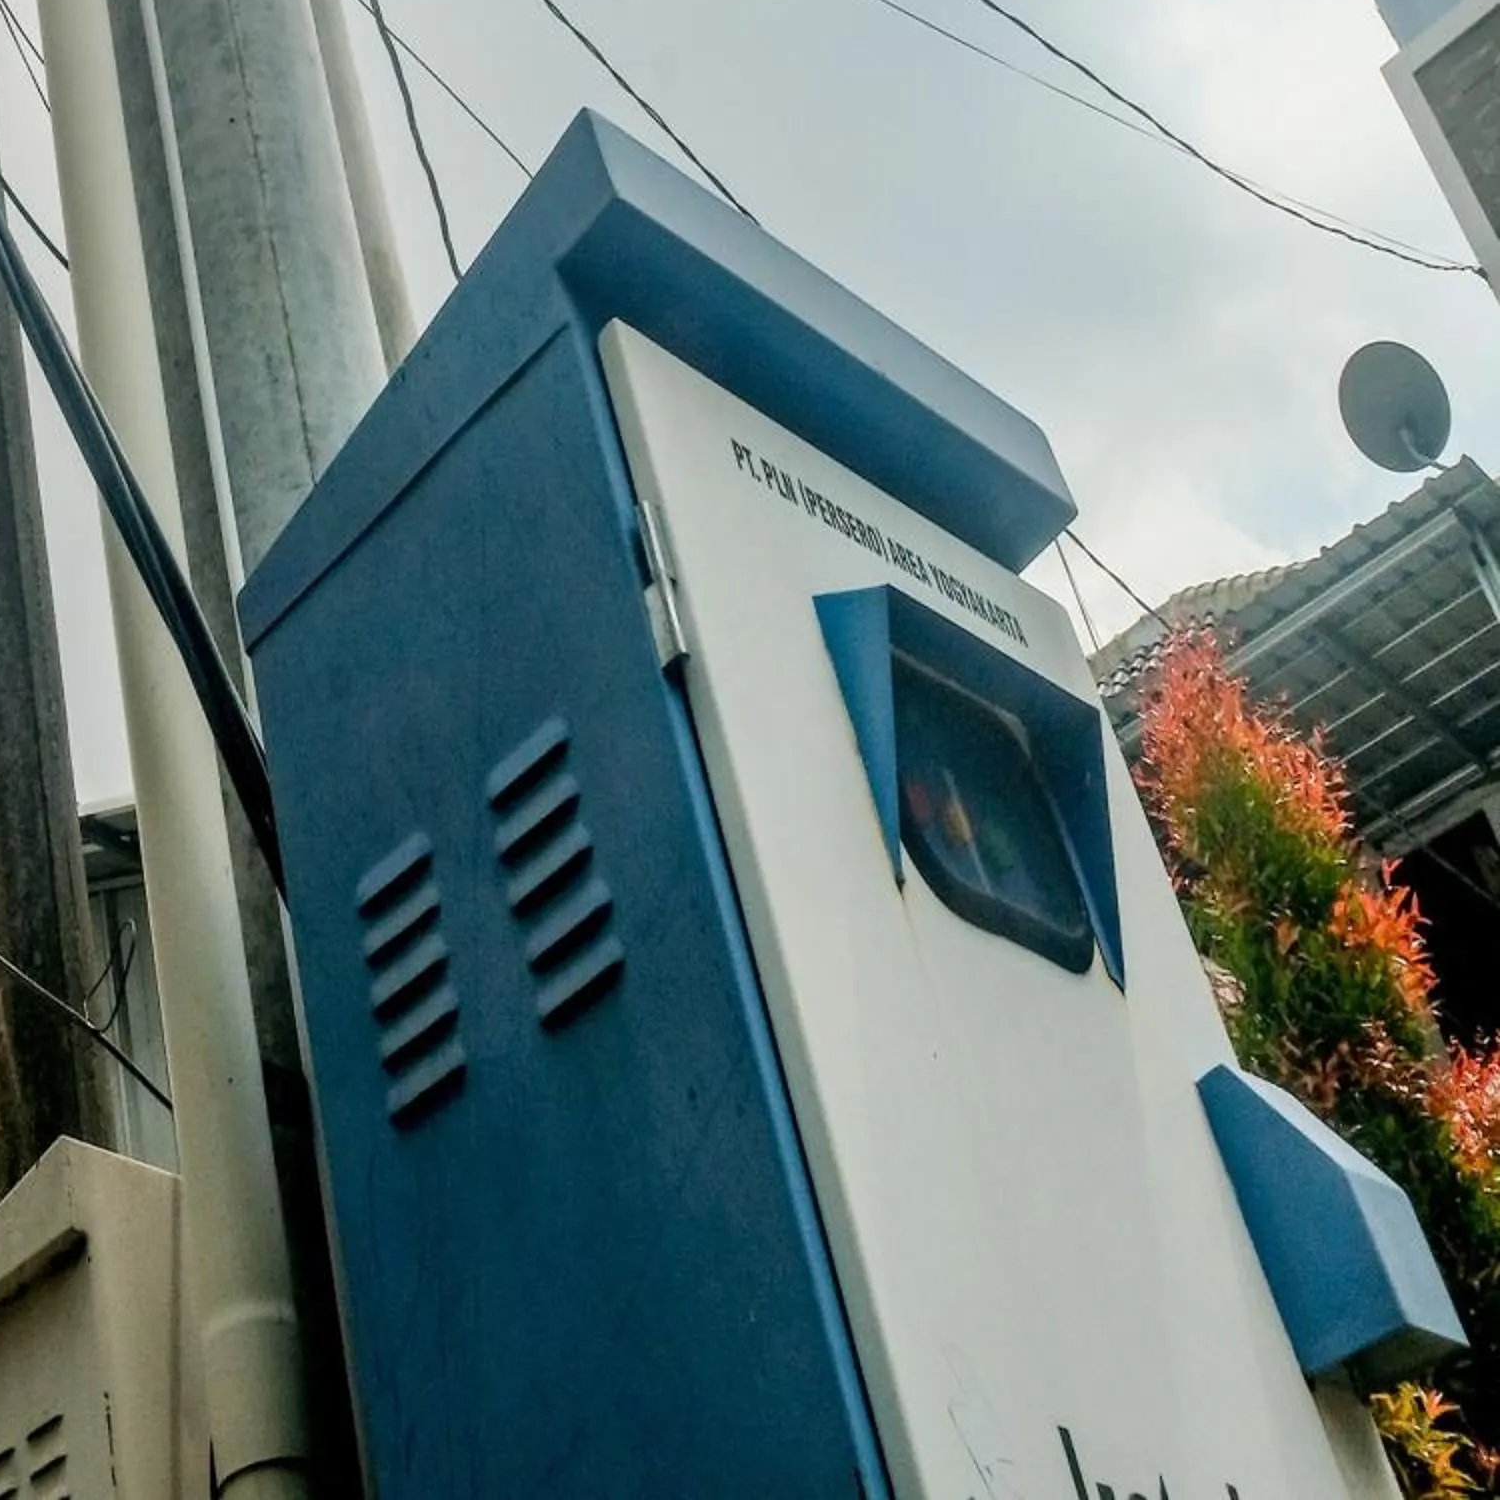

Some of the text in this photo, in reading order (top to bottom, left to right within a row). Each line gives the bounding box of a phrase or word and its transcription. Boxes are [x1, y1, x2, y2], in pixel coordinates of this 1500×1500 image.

[730, 437, 762, 482] PT.
[760, 457, 799, 507] PLN
[887, 537, 933, 587] AREA
[928, 562, 1029, 649] YOGYAKARTA
